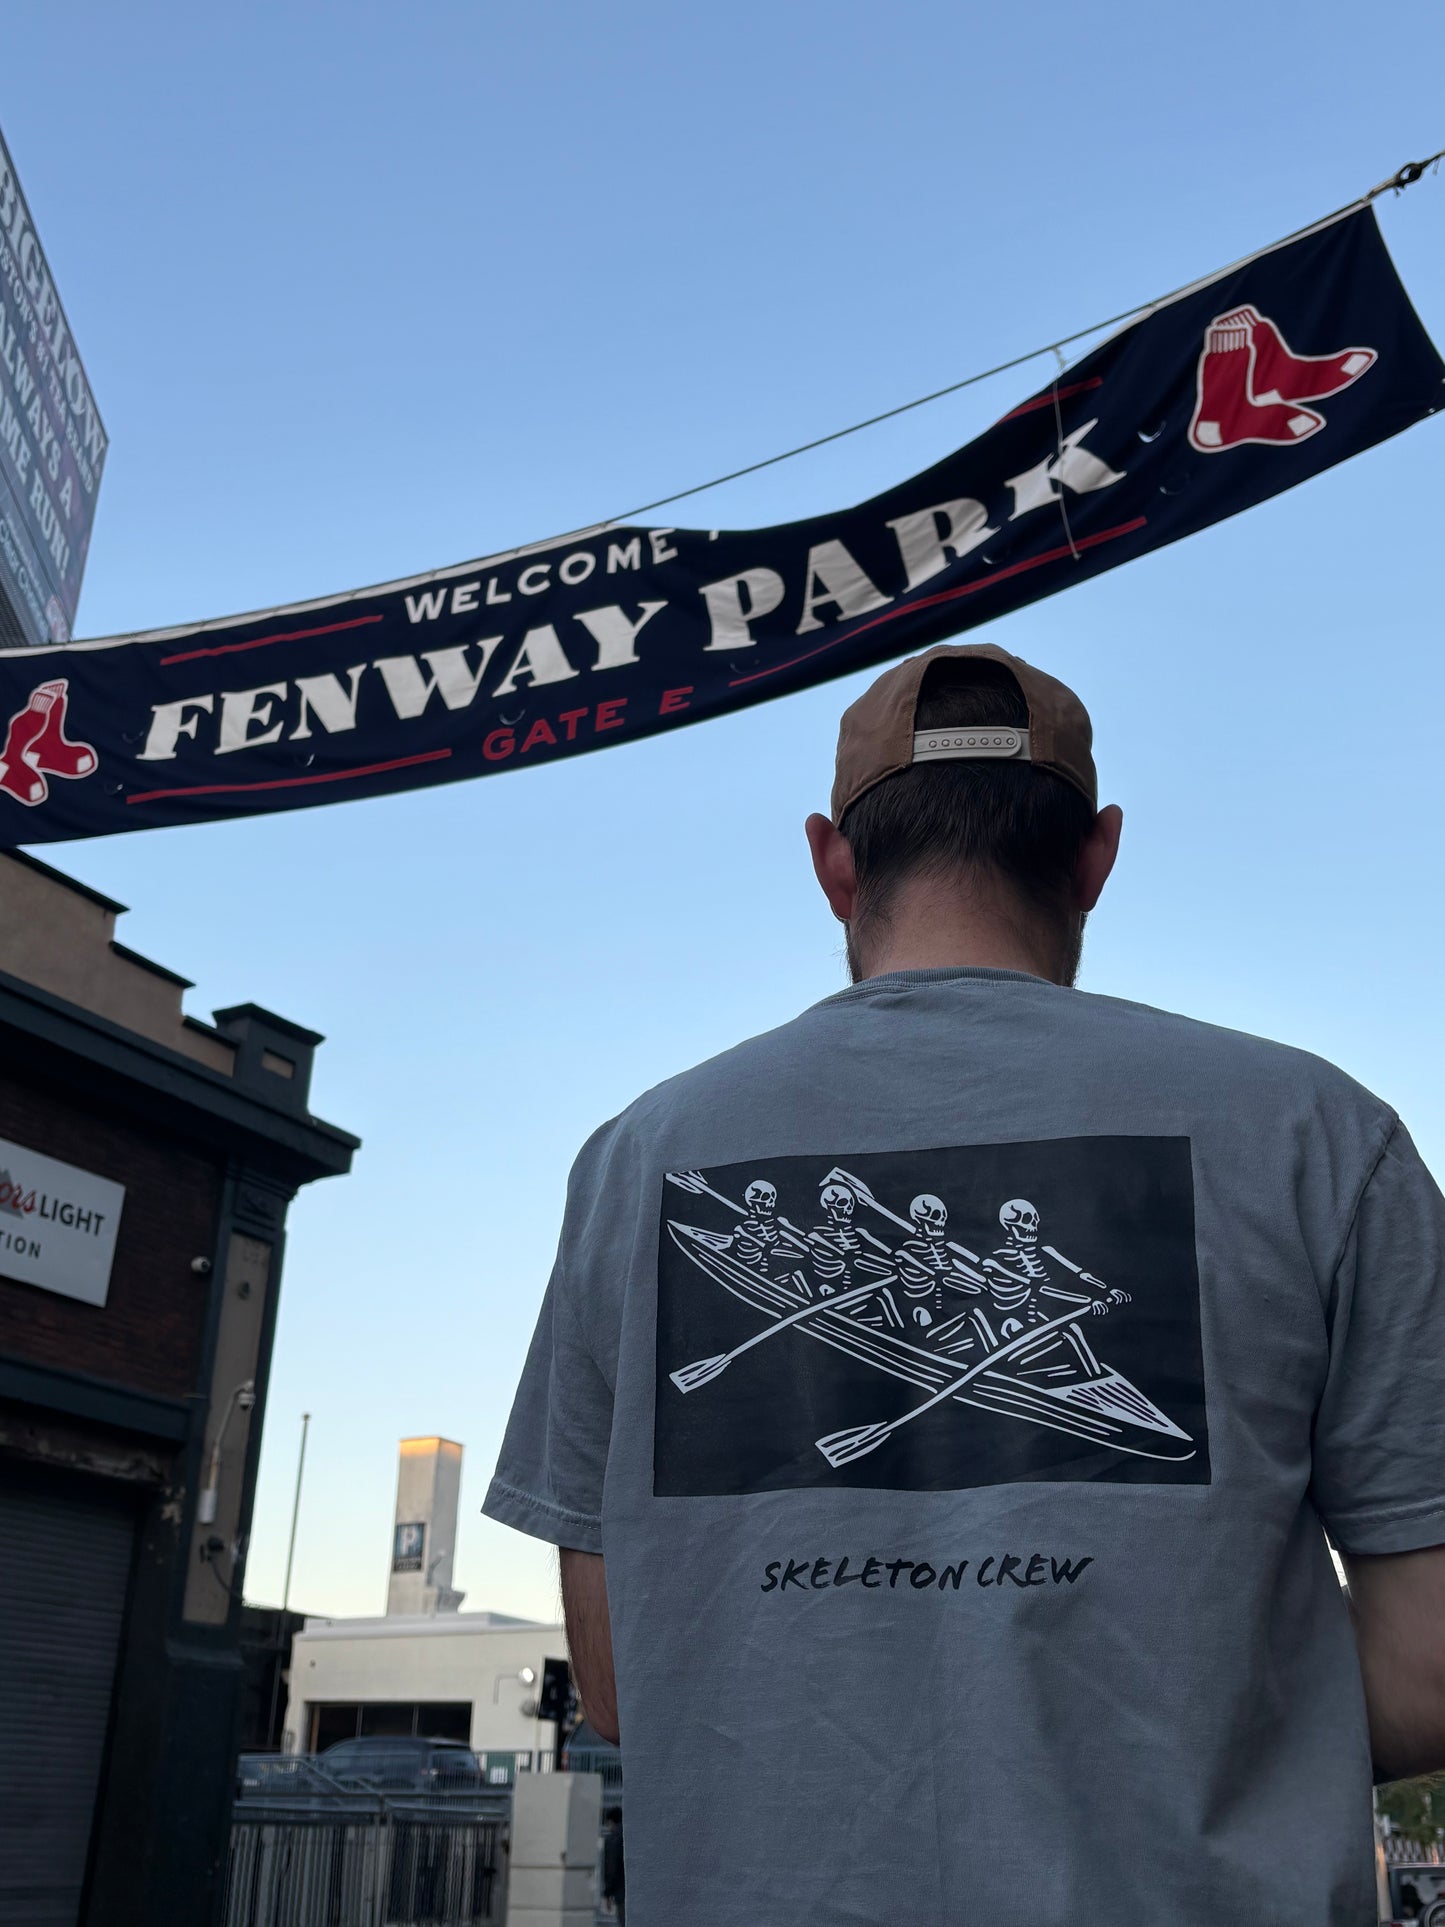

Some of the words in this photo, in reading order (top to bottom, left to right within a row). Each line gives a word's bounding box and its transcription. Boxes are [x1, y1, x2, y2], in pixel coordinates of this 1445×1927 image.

[0, 228, 37, 344] STON'S
[0, 390, 32, 486] ME
[29, 467, 70, 580] RUN!
[59, 475, 73, 521] A
[136, 600, 669, 762] FENWAY
[698, 417, 1128, 652] PARK
[404, 527, 679, 623] WELCOME
[482, 697, 628, 762] GATE
[658, 686, 694, 716] E
[39, 1194, 106, 1237] LIGHT
[400, 1526, 420, 1555] P
[760, 1556, 970, 1593] SKELETON
[976, 1553, 1095, 1588] CREW
